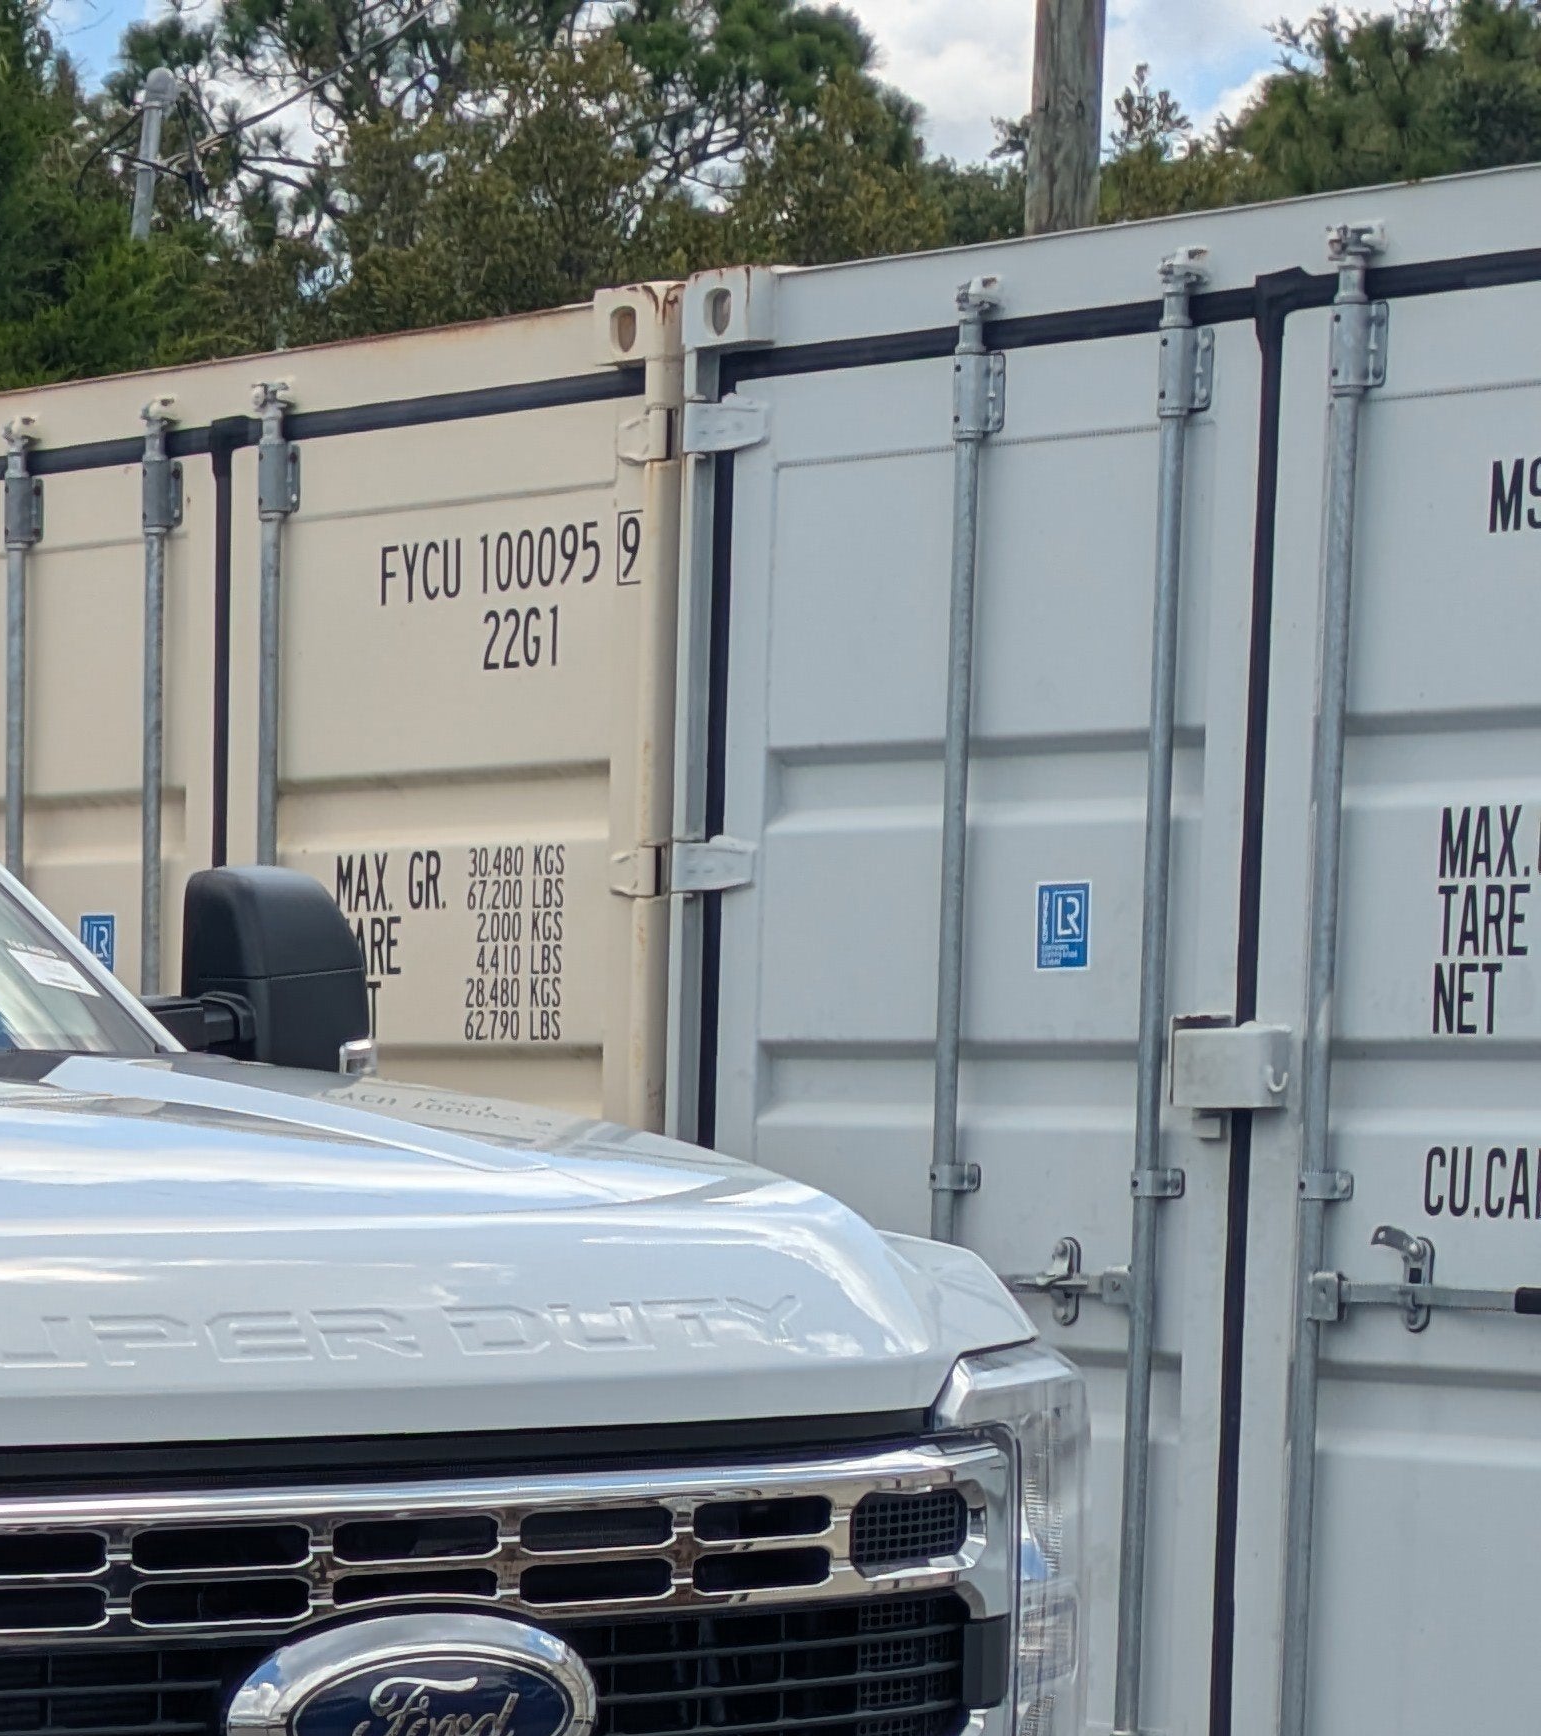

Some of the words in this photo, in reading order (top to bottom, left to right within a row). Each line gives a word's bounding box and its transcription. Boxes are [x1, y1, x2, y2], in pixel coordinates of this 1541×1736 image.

[381, 537, 461, 606] FYCU
[480, 521, 600, 594] 100095
[622, 517, 641, 578] 9
[483, 604, 558, 670] 22G1
[1439, 805, 1541, 878] MAX.
[336, 852, 392, 912] MAX.
[408, 850, 446, 910] GR.
[468, 846, 524, 877] 30.480
[533, 844, 565, 876] KGS
[467, 879, 523, 910] 67.200
[532, 877, 564, 909] LBS
[347, 915, 401, 975] ARE
[477, 912, 522, 943] 2.000
[531, 911, 563, 942] KGS
[1438, 883, 1531, 956] TARE
[465, 977, 520, 1009] 28.480
[530, 976, 562, 1008] KGS
[476, 944, 521, 976] 4.410
[531, 943, 563, 975] LBS
[529, 1009, 561, 1041] LBS
[1433, 962, 1503, 1034] NET
[1424, 1146, 1541, 1219] CU.CA
[441, 1294, 800, 1357] DUTY
